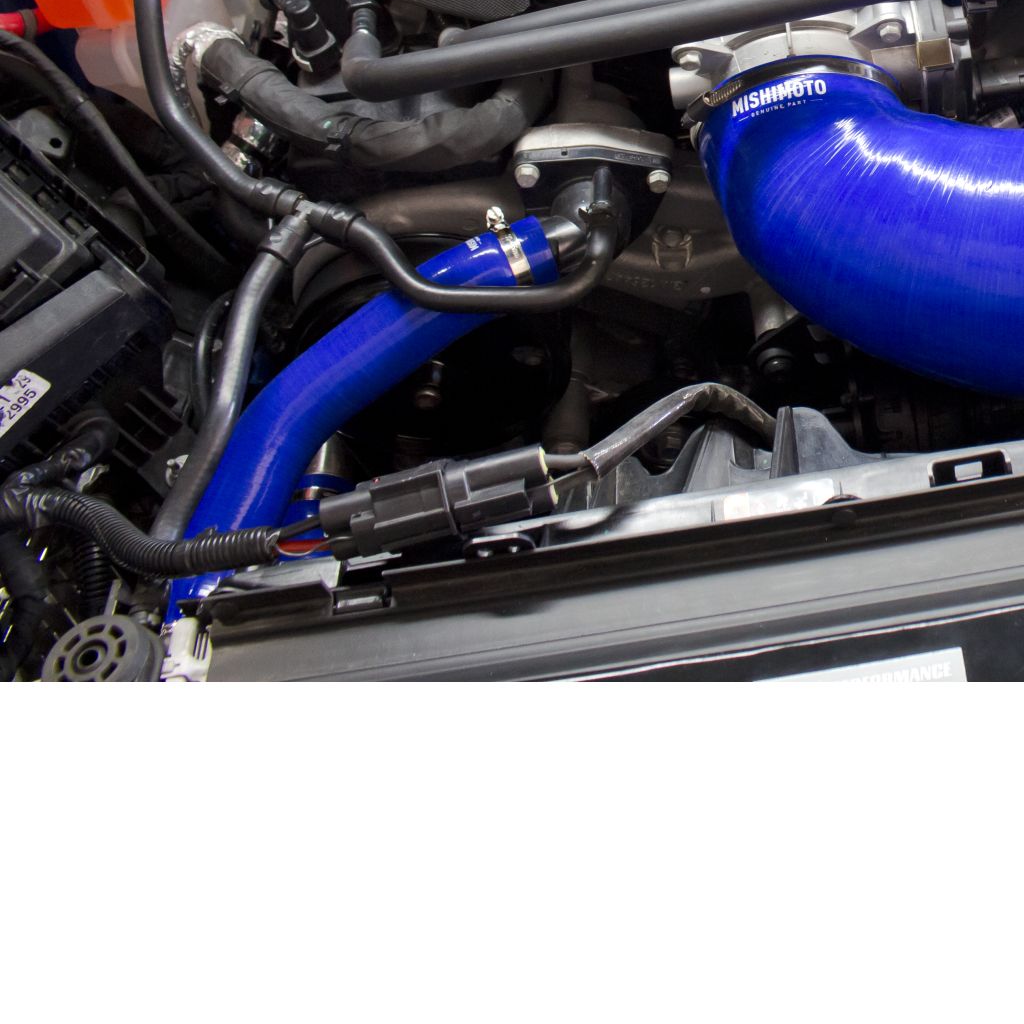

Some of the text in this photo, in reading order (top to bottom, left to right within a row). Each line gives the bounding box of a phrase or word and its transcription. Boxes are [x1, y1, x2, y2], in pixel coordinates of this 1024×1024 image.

[731, 79, 827, 117] MISHIMOTO
[787, 98, 807, 108] PART
[6, 388, 37, 420] 2995
